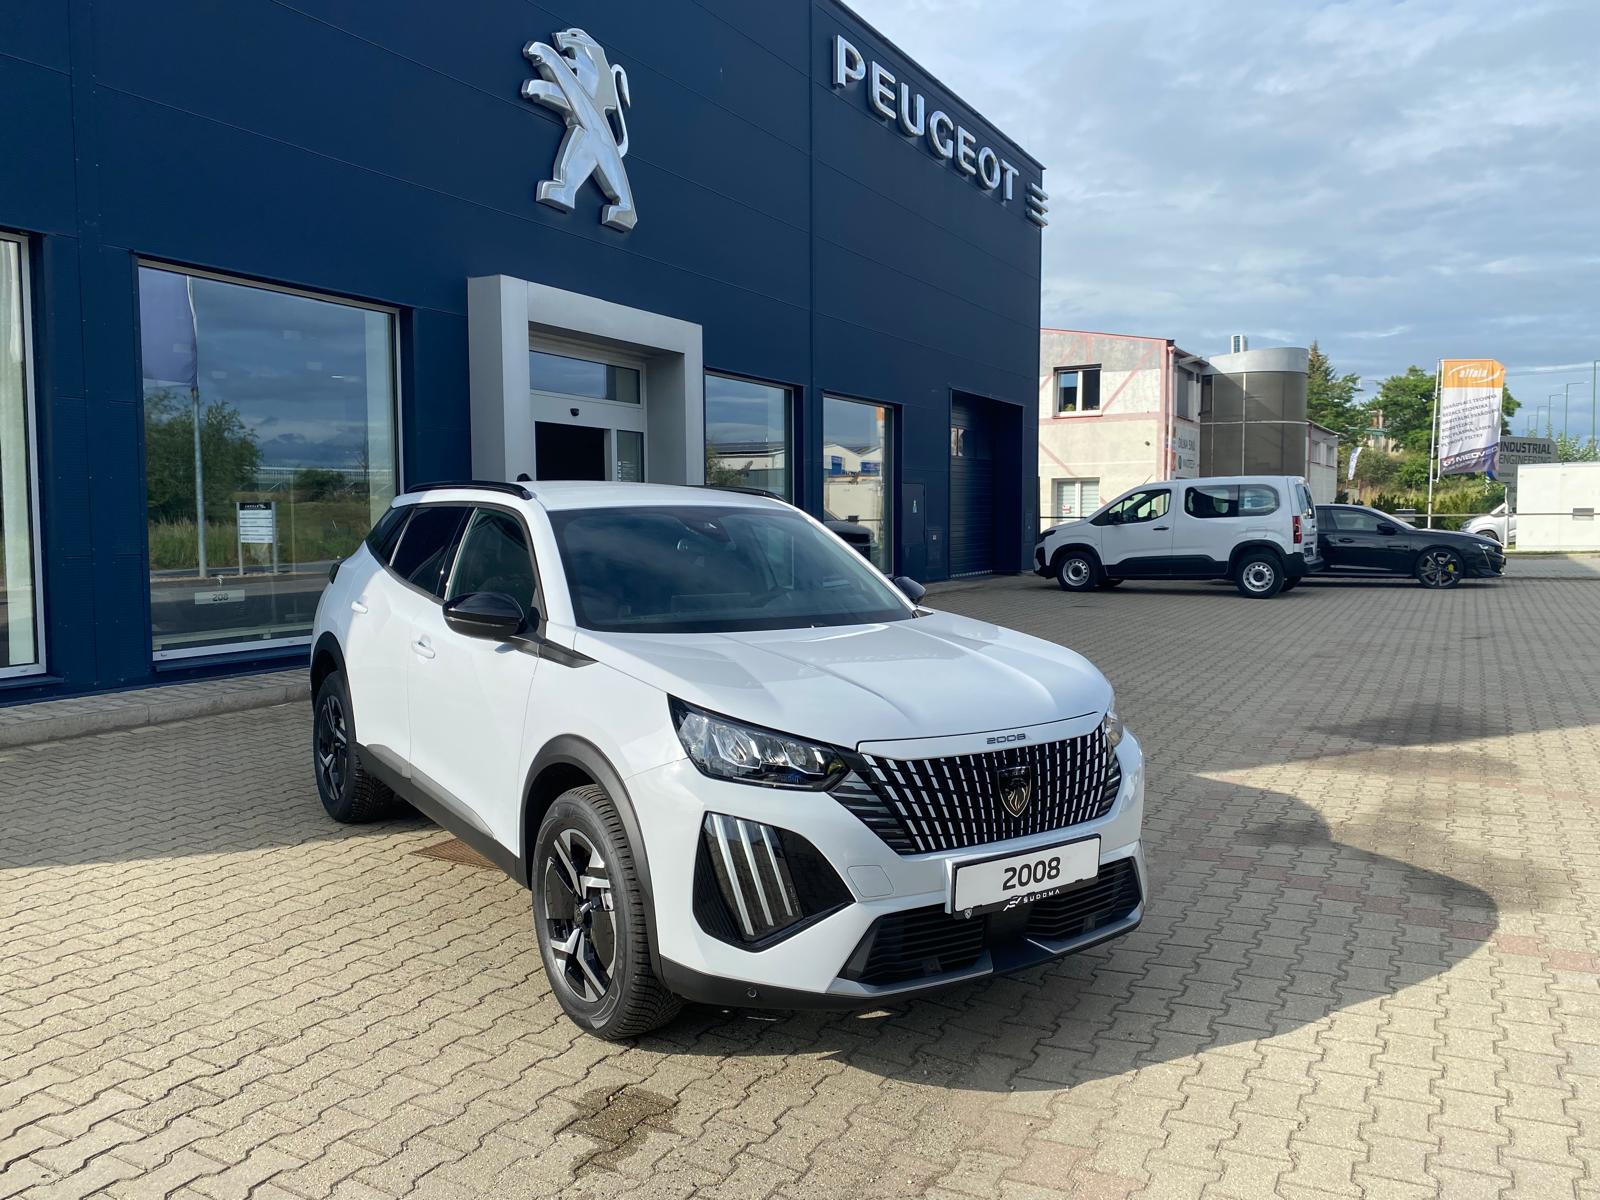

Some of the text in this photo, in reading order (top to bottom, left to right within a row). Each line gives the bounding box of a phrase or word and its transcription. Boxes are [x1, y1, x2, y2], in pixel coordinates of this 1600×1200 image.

[833, 35, 1019, 201] PEUGEOT
[1500, 441, 1551, 454] INDUSTRIAL
[986, 733, 1026, 745] 2008
[1002, 856, 1061, 891] 2008
